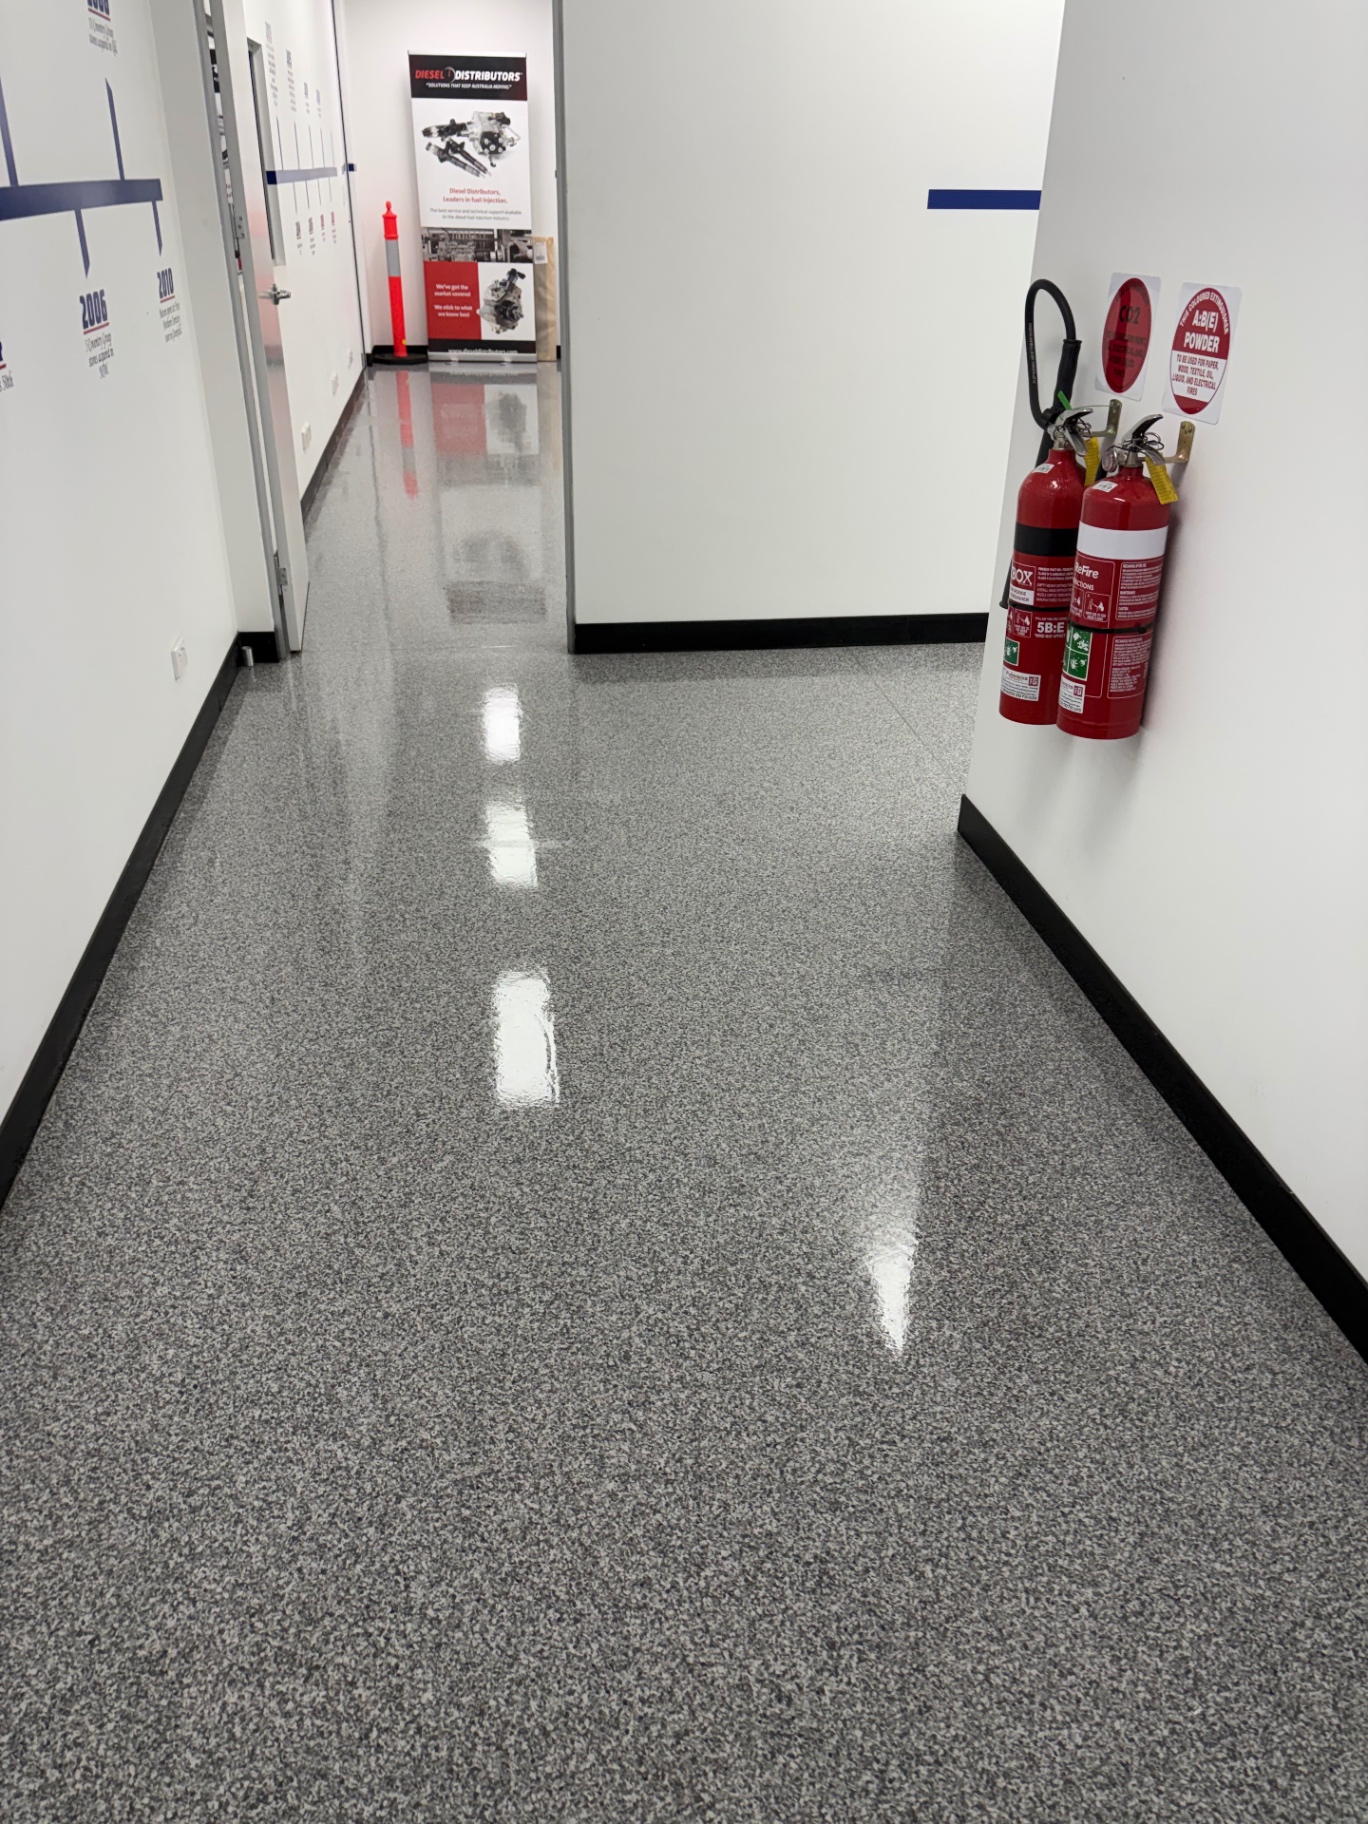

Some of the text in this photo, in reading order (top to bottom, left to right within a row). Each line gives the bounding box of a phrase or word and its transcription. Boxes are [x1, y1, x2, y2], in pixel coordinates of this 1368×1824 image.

[415, 70, 520, 82] DIESEL DISTRIBUTORS
[157, 267, 174, 299] 2010
[79, 289, 108, 330] 2006
[1119, 305, 1140, 324] CO2
[1180, 310, 1189, 326] THIS
[1192, 310, 1218, 333] A:B(E)
[1184, 332, 1220, 353] POWDER
[1177, 354, 1181, 362] TO
[1182, 355, 1187, 363] BE
[1187, 356, 1197, 365] USED
[1206, 359, 1218, 370] PAPER,
[1190, 367, 1205, 377] TEXTILE,
[1187, 386, 1198, 396] FIRES
[1194, 378, 1215, 390] ELECTRICAL
[1037, 622, 1064, 633] 5B:E
